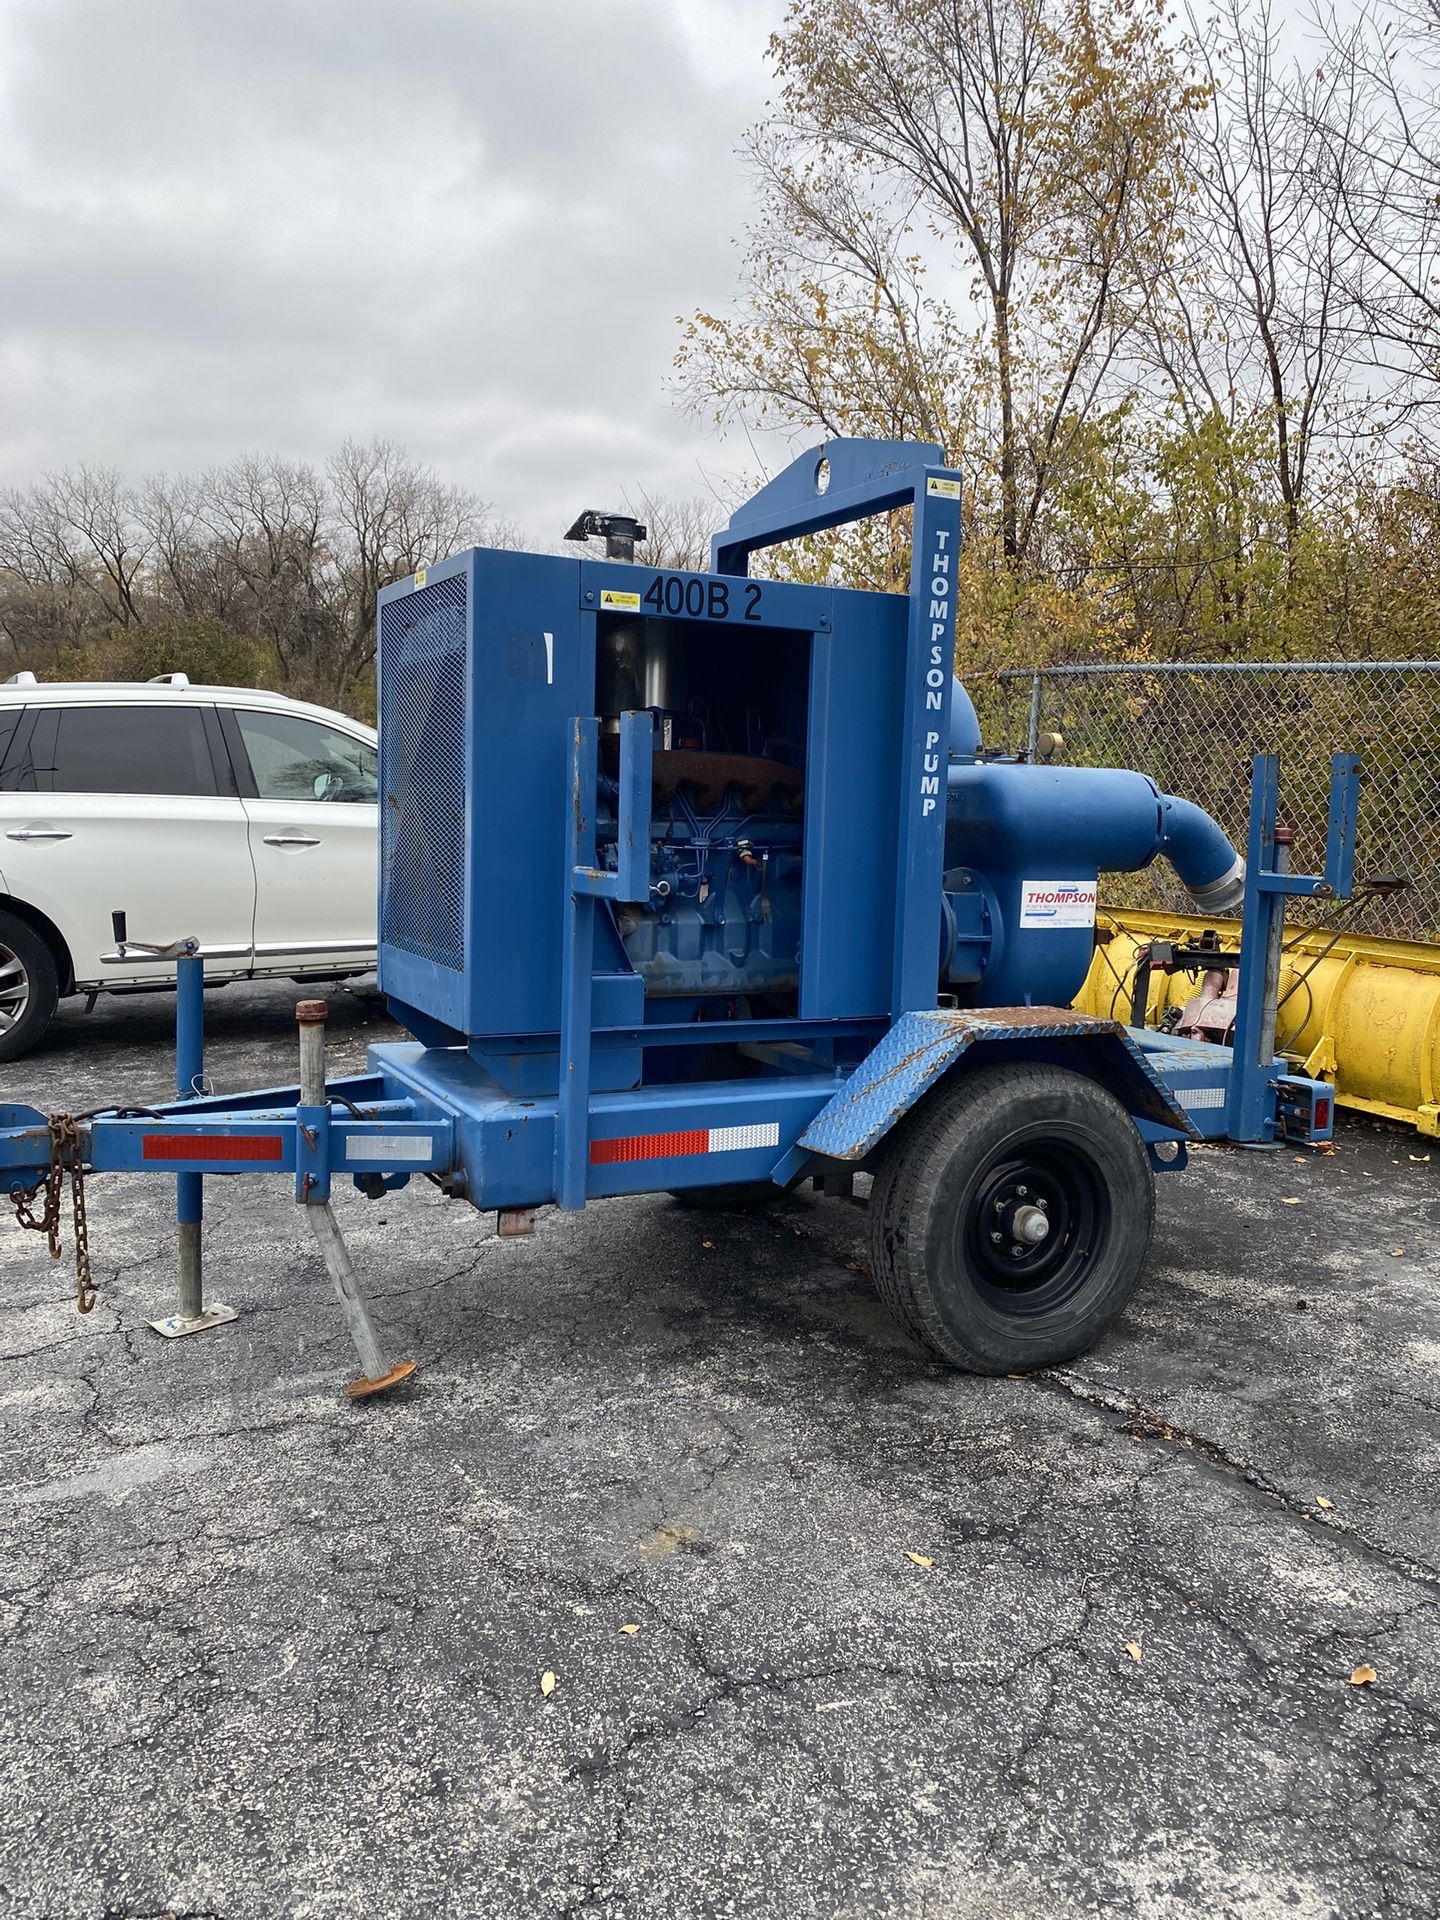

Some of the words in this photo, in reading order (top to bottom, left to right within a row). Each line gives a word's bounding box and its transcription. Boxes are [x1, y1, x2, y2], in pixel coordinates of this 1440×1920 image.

[644, 575, 730, 619] 400B
[744, 583, 762, 621] 2
[926, 530, 950, 710] THOMPSON
[920, 731, 940, 817] PUMP
[1028, 892, 1096, 903] THOMPSON
